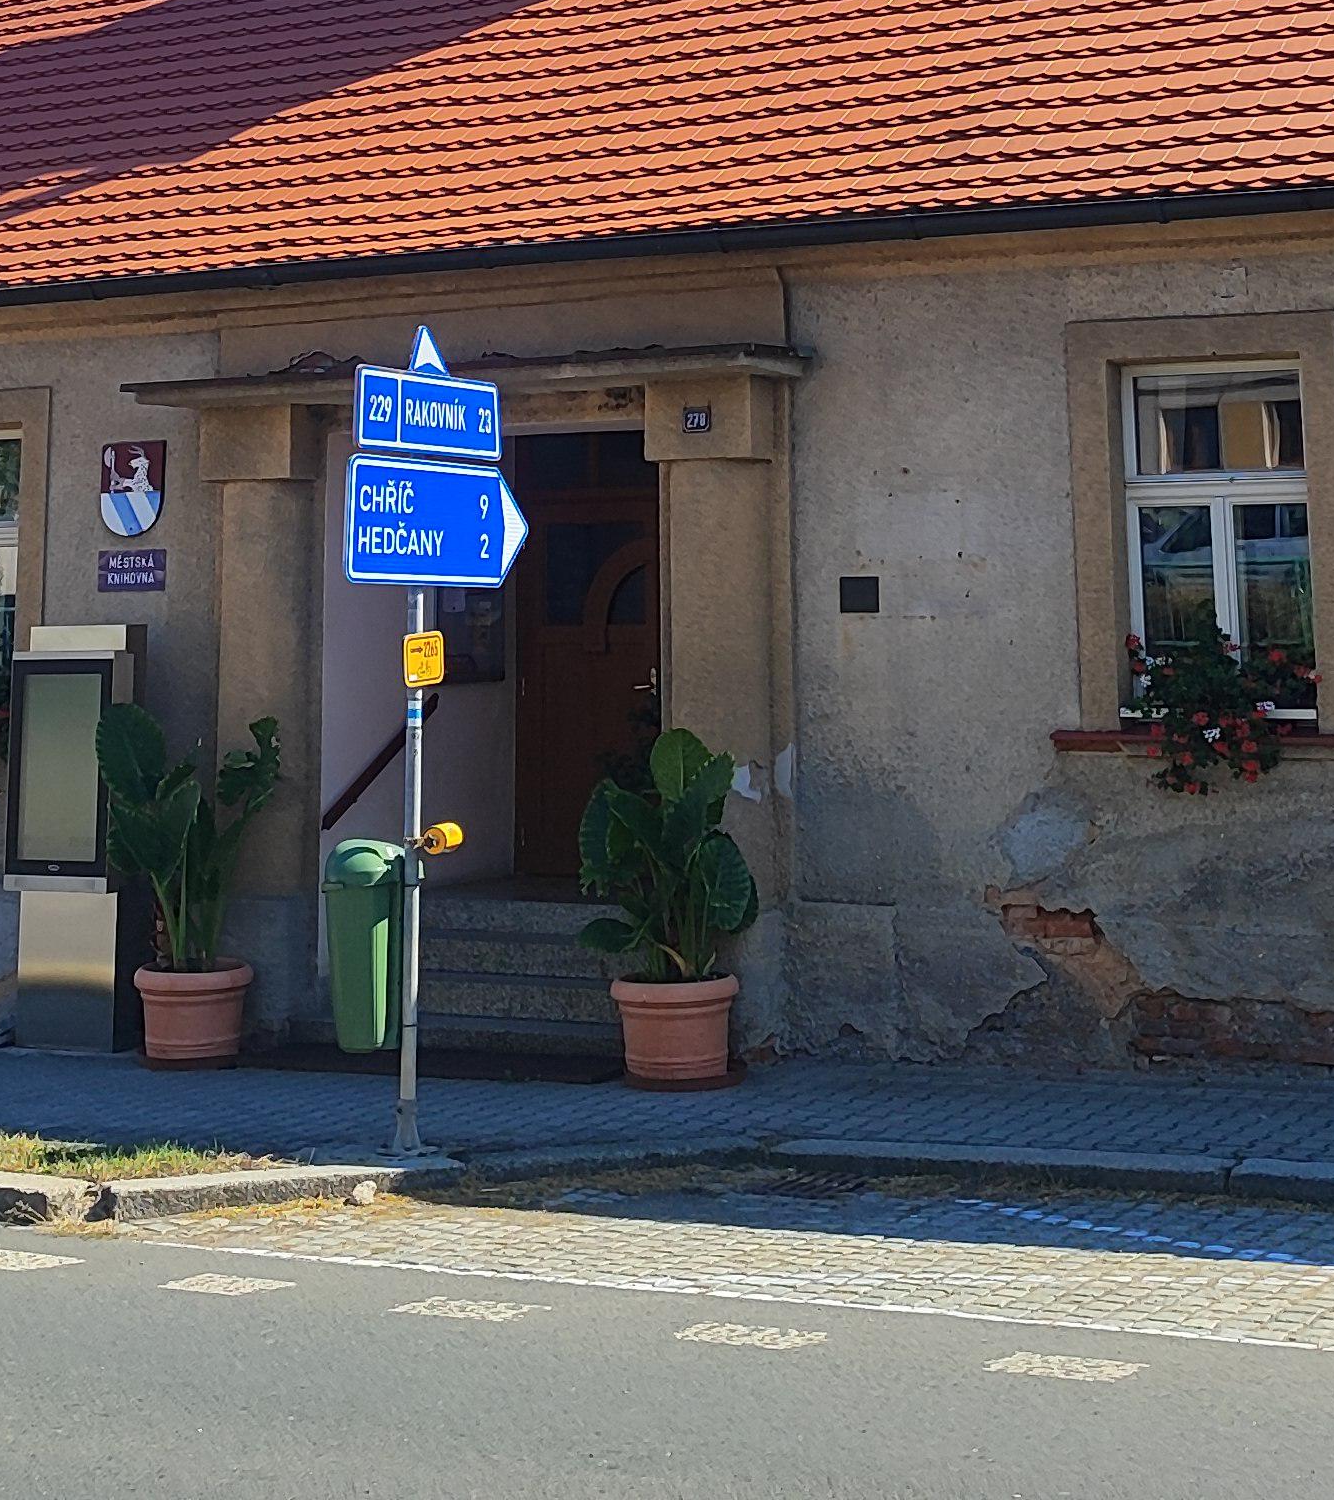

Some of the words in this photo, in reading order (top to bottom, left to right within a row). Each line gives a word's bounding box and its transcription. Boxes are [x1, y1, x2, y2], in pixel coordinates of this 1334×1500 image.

[368, 394, 392, 423] 229
[405, 398, 467, 431] RAKOVNÍK
[478, 407, 492, 435] 23
[359, 480, 415, 515] CHŘÍČ
[479, 494, 489, 520] 9
[357, 520, 444, 557] HEDČANY
[479, 533, 490, 559] 2
[107, 572, 155, 585] KNIHOVNA
[108, 553, 155, 569] MĚSTSKÁ
